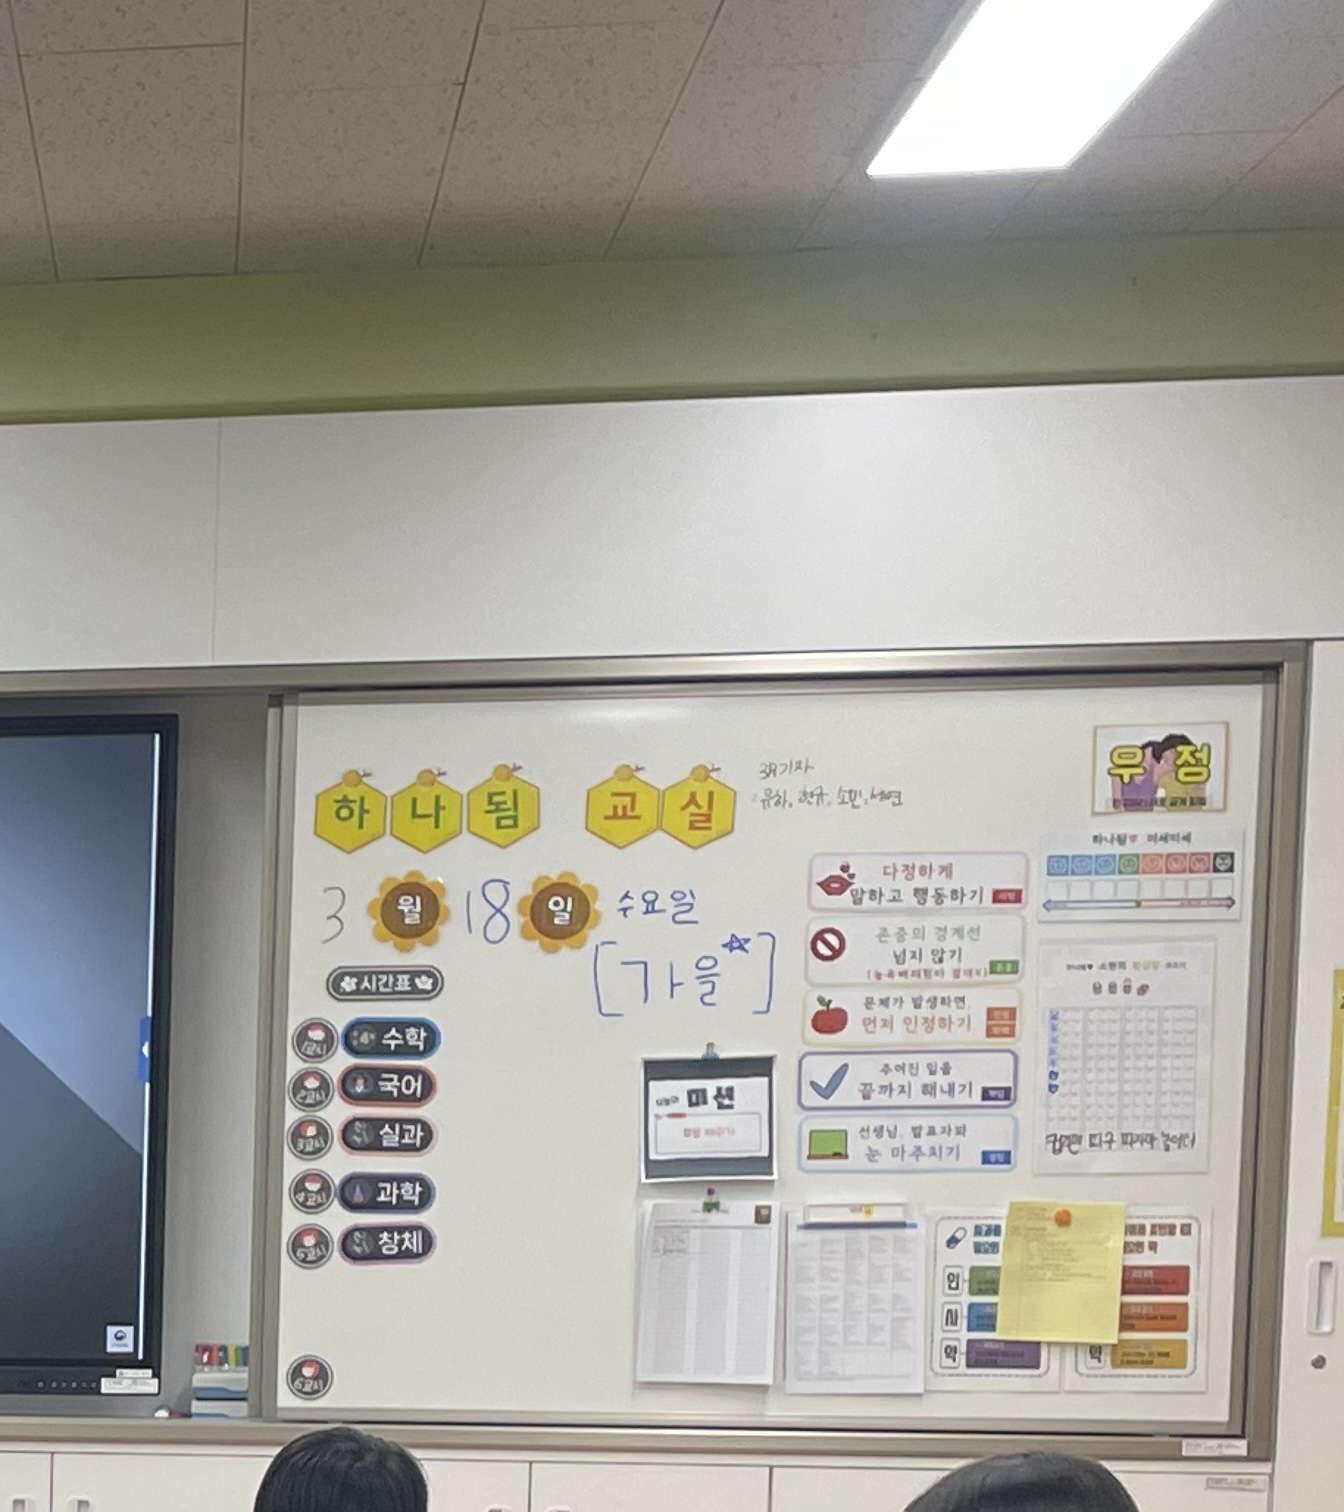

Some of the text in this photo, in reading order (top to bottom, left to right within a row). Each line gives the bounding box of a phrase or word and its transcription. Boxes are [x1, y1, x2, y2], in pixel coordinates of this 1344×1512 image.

[1107, 742, 1211, 784] 우정
[333, 790, 713, 832] 하나됨 교실
[883, 863, 954, 881] 다정하게
[850, 887, 985, 905] 말하고 행동하기
[323, 879, 699, 944] 3 월 18 일 수요일
[876, 925, 981, 943] 존중의 경계선
[893, 948, 923, 965] 넘지
[361, 974, 411, 993] 시간표
[864, 996, 904, 1010] 문제가
[862, 1016, 894, 1034] 먼저
[903, 1016, 972, 1034] 인정하기
[382, 1027, 427, 1051] 수학
[378, 1073, 423, 1098] 국어
[858, 1081, 973, 1100] 끝까지 해내기
[686, 1085, 735, 1110] 미션
[379, 1122, 425, 1147] 실과
[865, 1144, 960, 1163] 눈 마주치기
[376, 1181, 423, 1205] 과학
[378, 1230, 423, 1254] 창체
